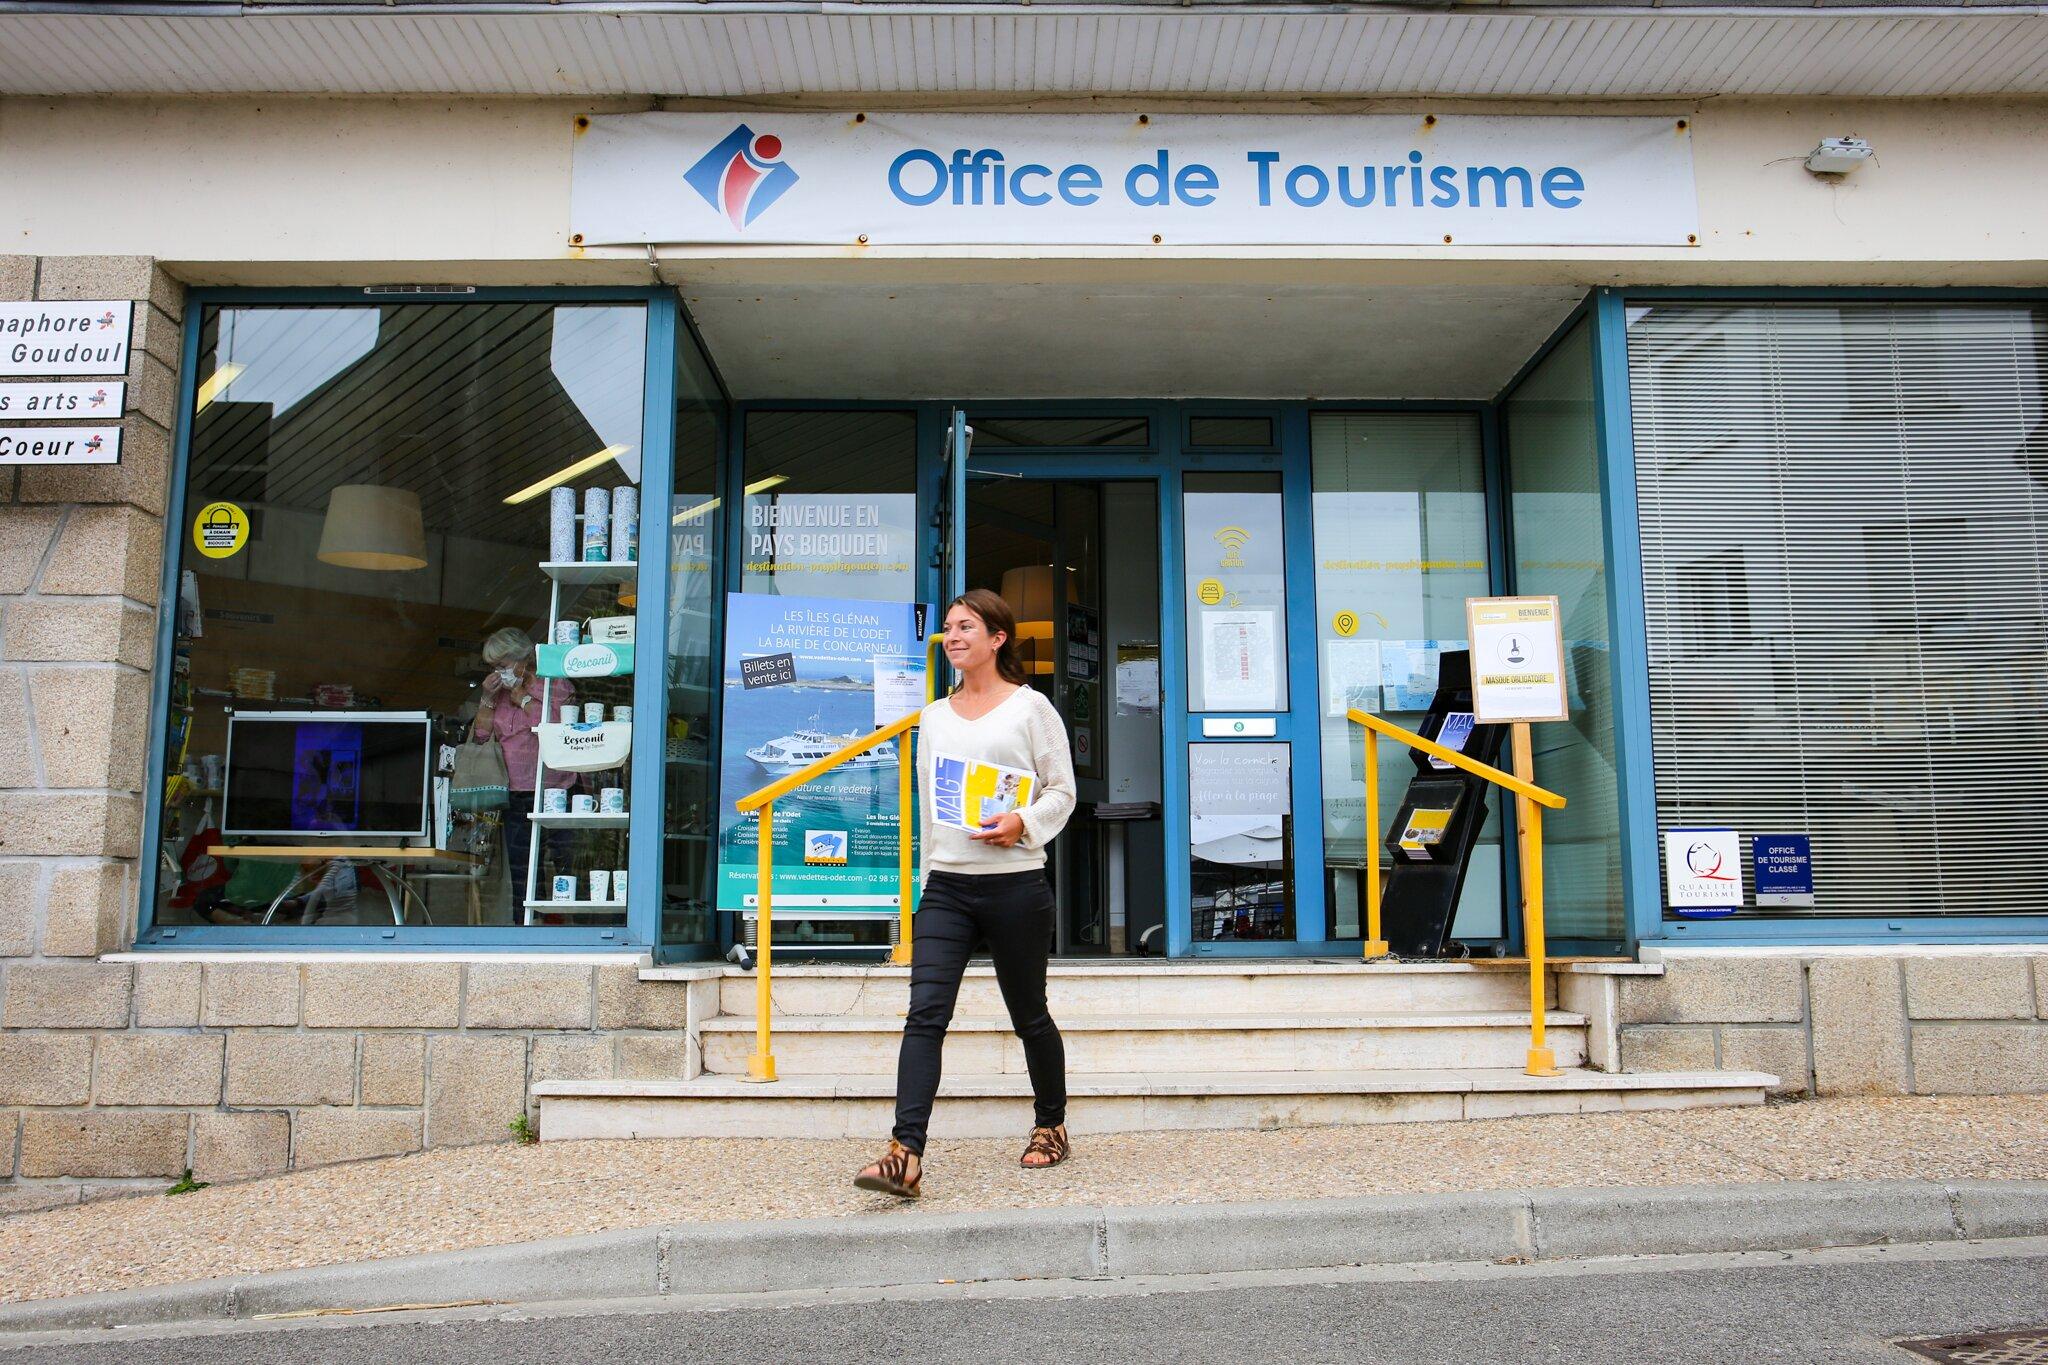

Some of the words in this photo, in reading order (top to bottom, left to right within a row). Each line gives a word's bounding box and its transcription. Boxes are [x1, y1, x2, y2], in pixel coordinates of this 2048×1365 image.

[888, 149, 1103, 206] Office
[1124, 150, 1220, 206] de
[1247, 150, 1585, 209] Tourisme
[11, 343, 122, 363] Goudoul
[26, 393, 79, 411] arts
[752, 505, 850, 527] BIENVENUE
[857, 505, 879, 527] EN
[751, 534, 795, 556] PAYS
[800, 534, 888, 556] BIGOUDEN
[784, 610, 804, 622] LES
[807, 609, 830, 624] ÎLES
[832, 612, 879, 626] GLÉNAN
[1518, 608, 1550, 617] BIENVENUE
[770, 624, 785, 635] LA
[788, 625, 830, 637] RIVIÈRE
[833, 628, 849, 638] DE
[852, 628, 892, 640] L'ODET
[758, 637, 772, 648] LA
[776, 638, 801, 649] BAIE
[804, 640, 820, 650] DE
[823, 640, 902, 655] CONCARNEAU
[566, 653, 614, 673] Lesconil
[743, 660, 775, 673] Billets
[777, 658, 791, 667] en
[747, 672, 778, 685] vente
[780, 669, 792, 680] ici
[1485, 676, 1510, 685] MASQUE
[1511, 674, 1548, 684] OBLIGATOIRE
[563, 733, 606, 745] Lesconil
[824, 785, 836, 793] en
[839, 784, 872, 795] vedette
[1770, 856, 1808, 864] TOURISME
[1768, 865, 1798, 873] CLASSÉ
[780, 873, 863, 882] www.vedettes-odet.com
